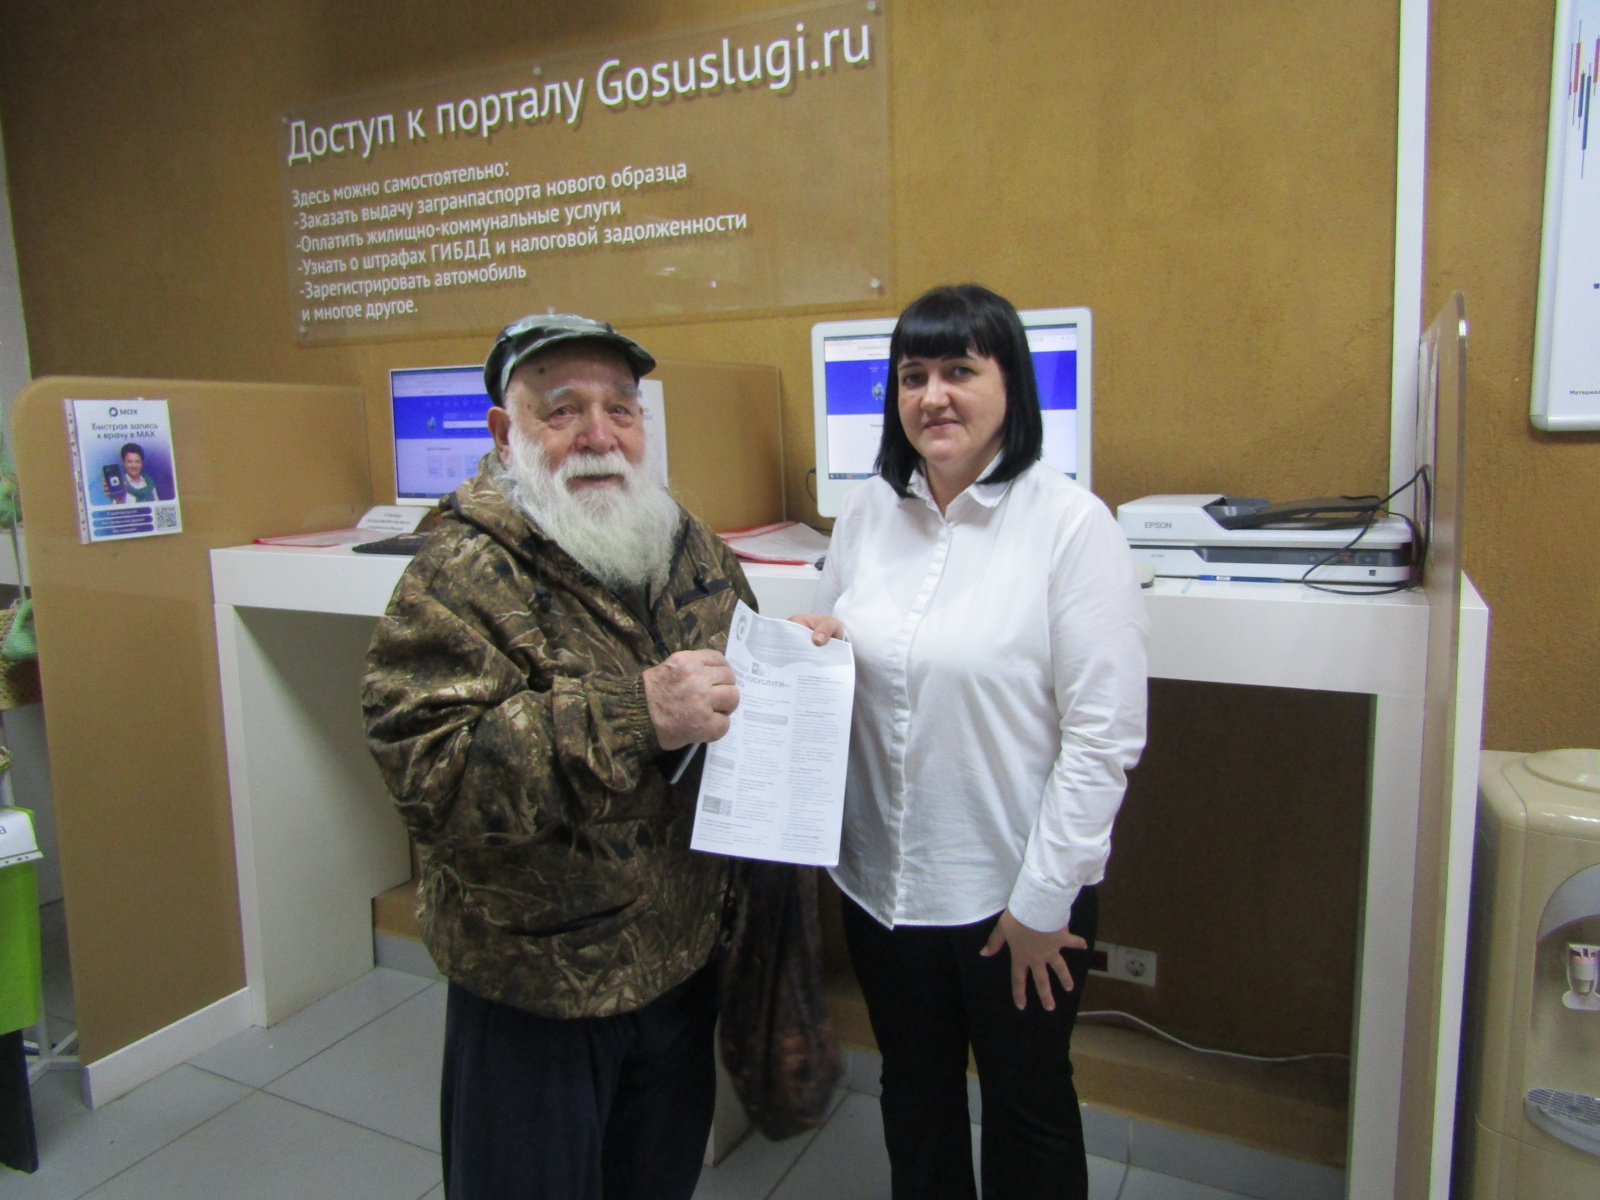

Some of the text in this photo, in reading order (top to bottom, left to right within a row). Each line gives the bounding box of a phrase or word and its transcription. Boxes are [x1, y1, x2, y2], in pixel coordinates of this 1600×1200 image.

[287, 22, 871, 167] Доступ к порталу Gosuslugi.ru
[291, 161, 510, 208] Здесь можно самостоятельно:
[294, 162, 688, 230] -Заказать выдачу загранпаспорта нового образца
[296, 200, 622, 252] -Оплатить жилищно-коммунальные услуги
[298, 213, 747, 276] -Узнать о штрафах ГИБДД и налоговой задолженности
[300, 262, 527, 301] -Зарегистрировать автомобиль
[301, 298, 419, 322] и многое другое.
[92, 423, 128, 431] Быстрая
[103, 432, 128, 440] врачу
[1144, 521, 1172, 529] EPSON
